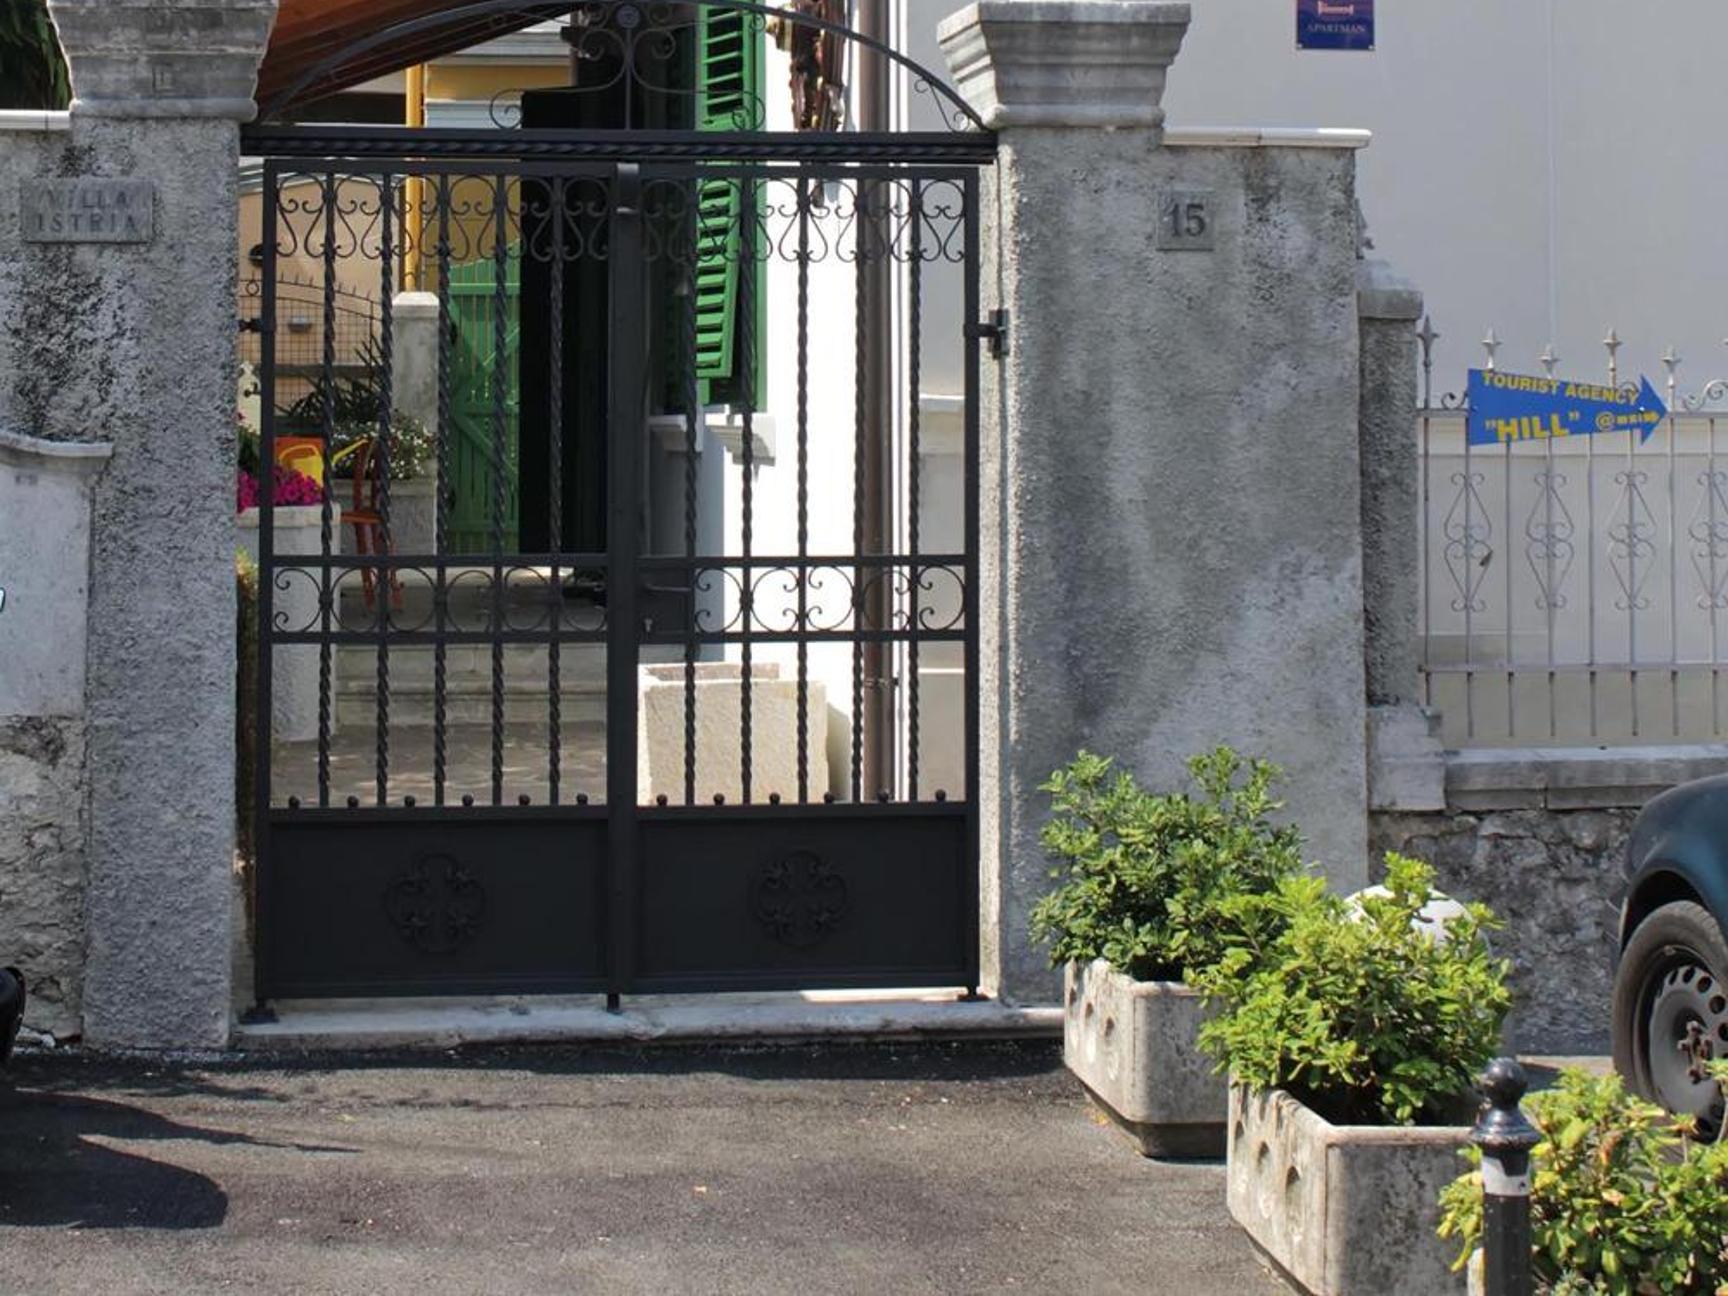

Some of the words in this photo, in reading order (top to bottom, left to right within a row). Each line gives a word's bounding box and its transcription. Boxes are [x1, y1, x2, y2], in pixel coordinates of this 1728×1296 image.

[1169, 203, 1206, 237] 15
[1482, 370, 1560, 395] TOURIST
[1564, 383, 1639, 405] AGENCY
